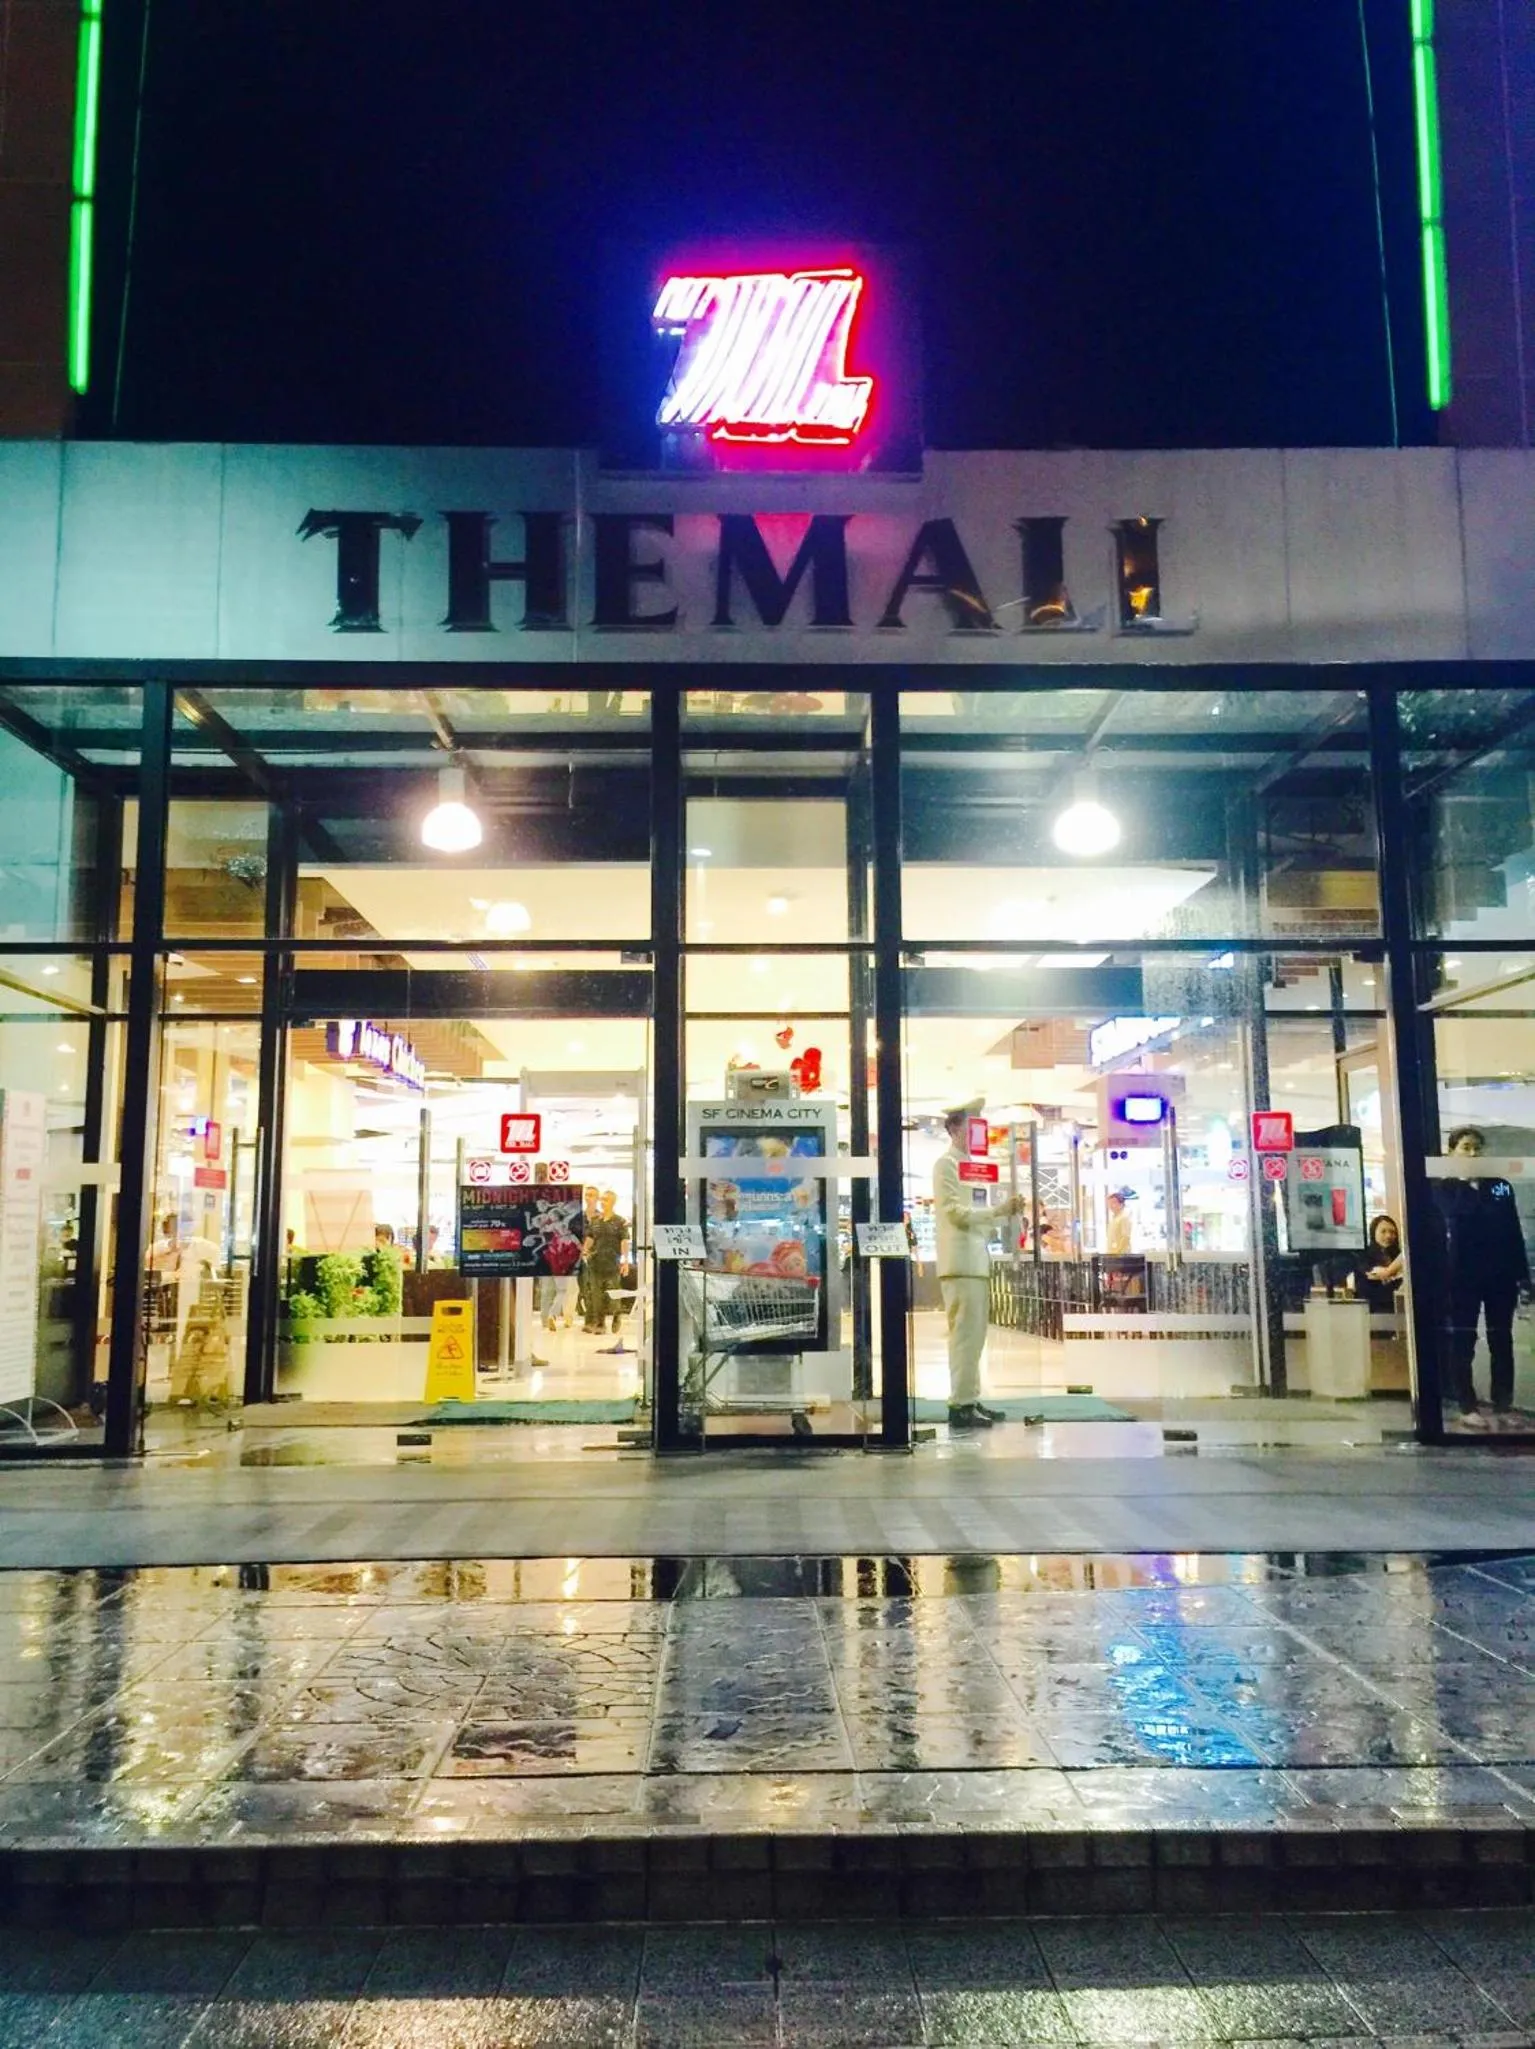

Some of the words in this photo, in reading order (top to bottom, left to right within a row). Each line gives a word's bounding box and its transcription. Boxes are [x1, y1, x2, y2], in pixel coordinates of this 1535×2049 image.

[296, 508, 678, 634] THE
[701, 1108, 720, 1119] SF
[725, 1108, 784, 1119] CINEMA
[787, 1108, 823, 1119] CITY
[463, 1188, 537, 1204] MIDNIGHT
[672, 1247, 689, 1255] IN
[864, 1245, 903, 1253] OUT
